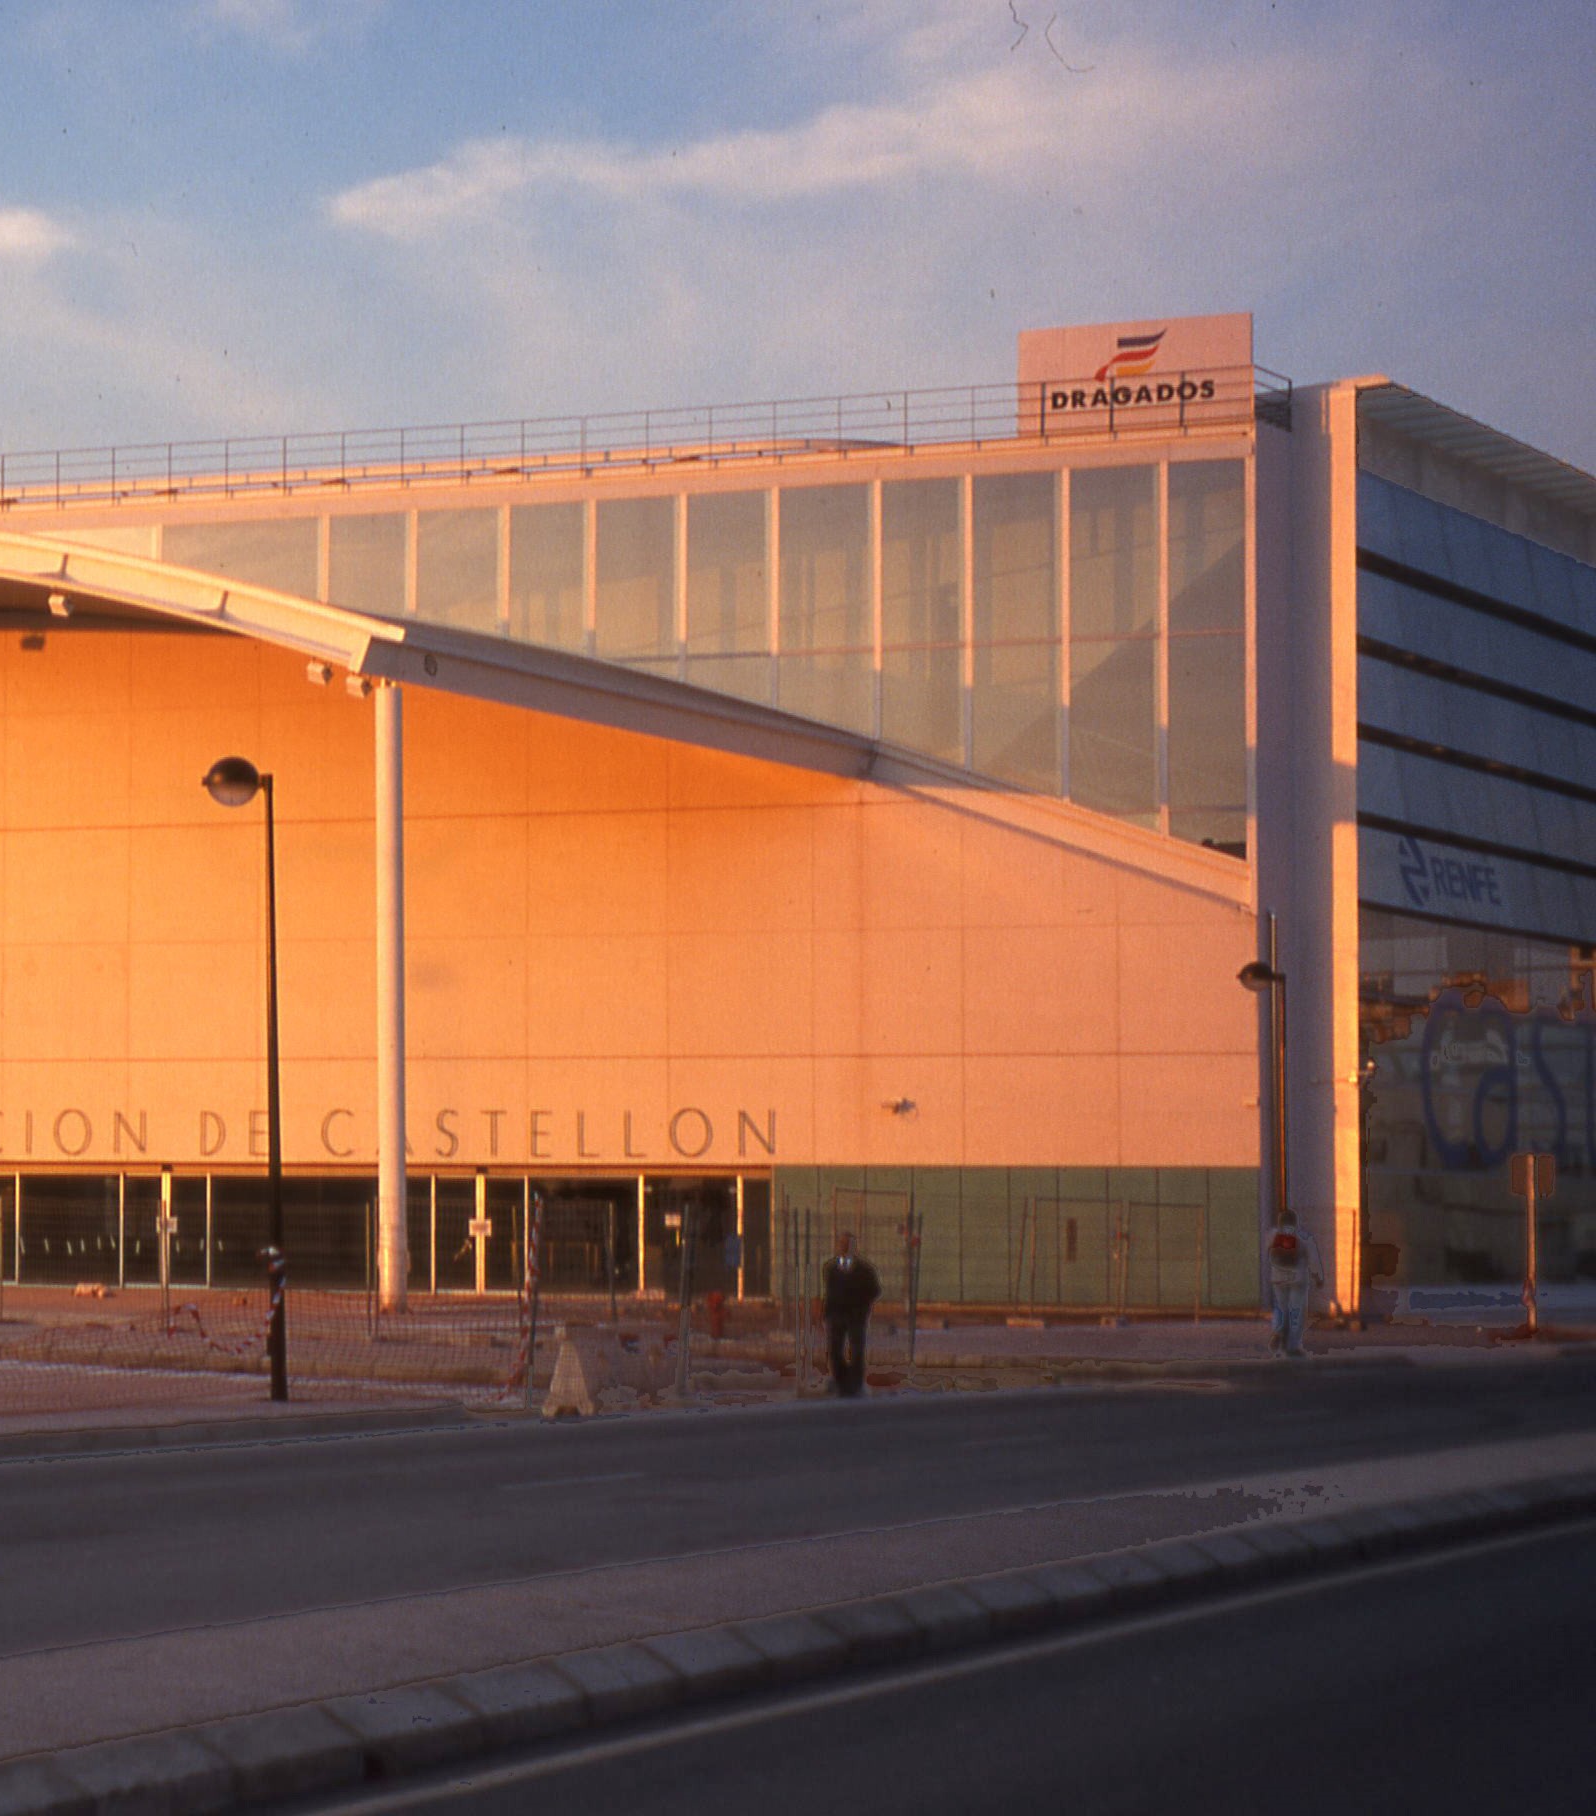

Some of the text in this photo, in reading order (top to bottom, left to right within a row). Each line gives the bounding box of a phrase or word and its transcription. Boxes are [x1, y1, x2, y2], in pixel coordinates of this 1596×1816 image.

[1051, 379, 1215, 410] DRAGADOS
[1430, 856, 1502, 906] RENFE
[199, 1110, 270, 1157] DE
[320, 1107, 777, 1158] CSTELLON
